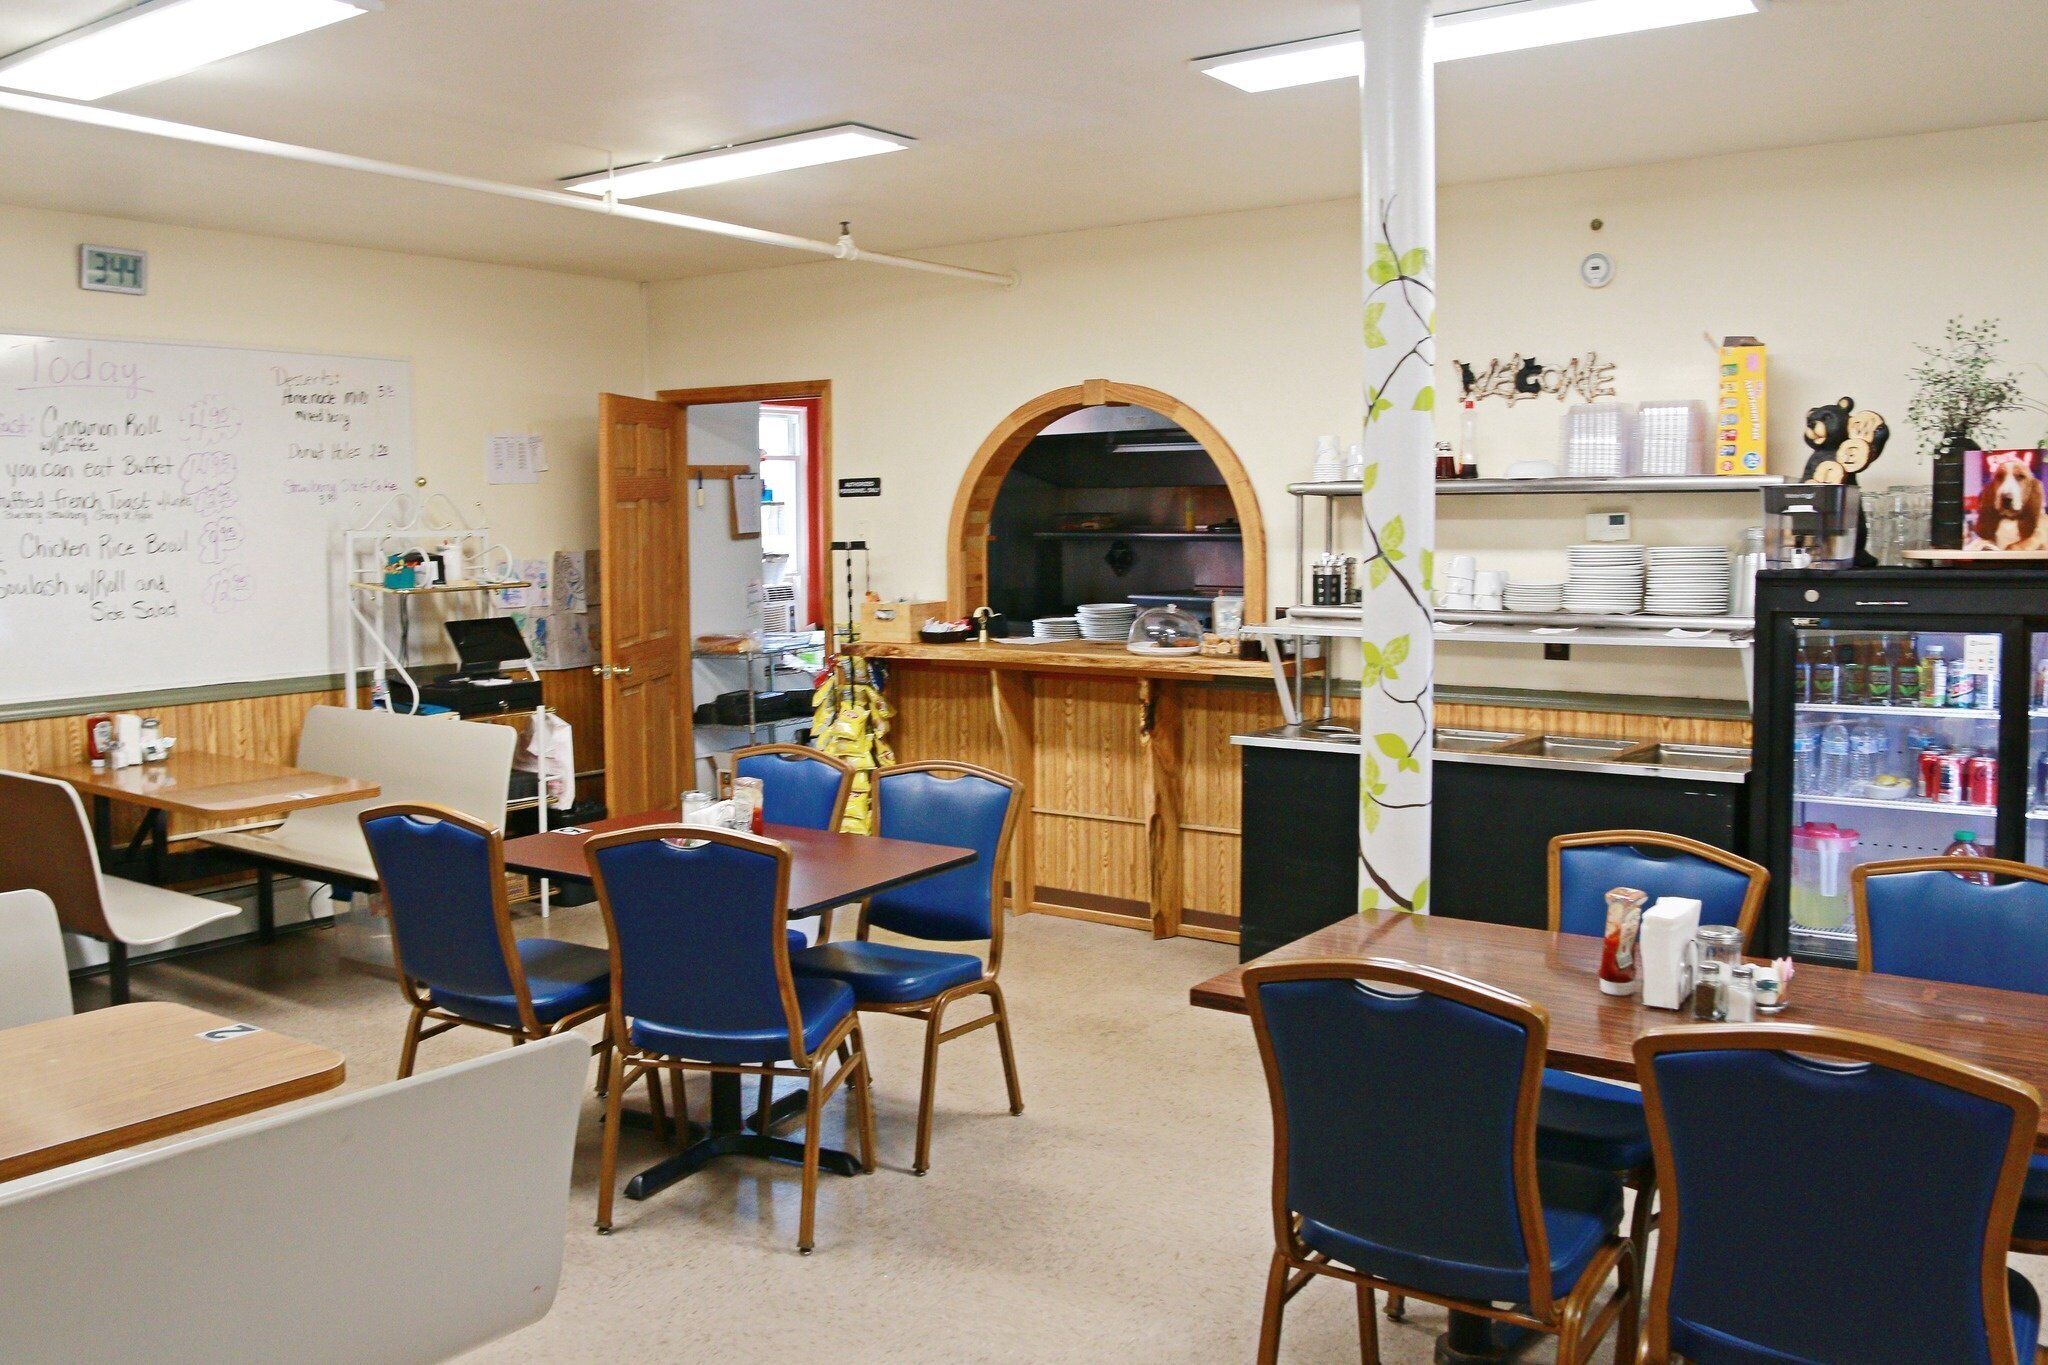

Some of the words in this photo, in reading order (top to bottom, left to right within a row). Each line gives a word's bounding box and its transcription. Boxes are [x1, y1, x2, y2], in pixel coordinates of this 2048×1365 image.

[10, 340, 146, 400] Today
[1452, 351, 1616, 408] WELCOME
[5, 462, 37, 487] you
[41, 462, 73, 478] can
[83, 457, 116, 478] eat
[20, 532, 90, 559] Chicken
